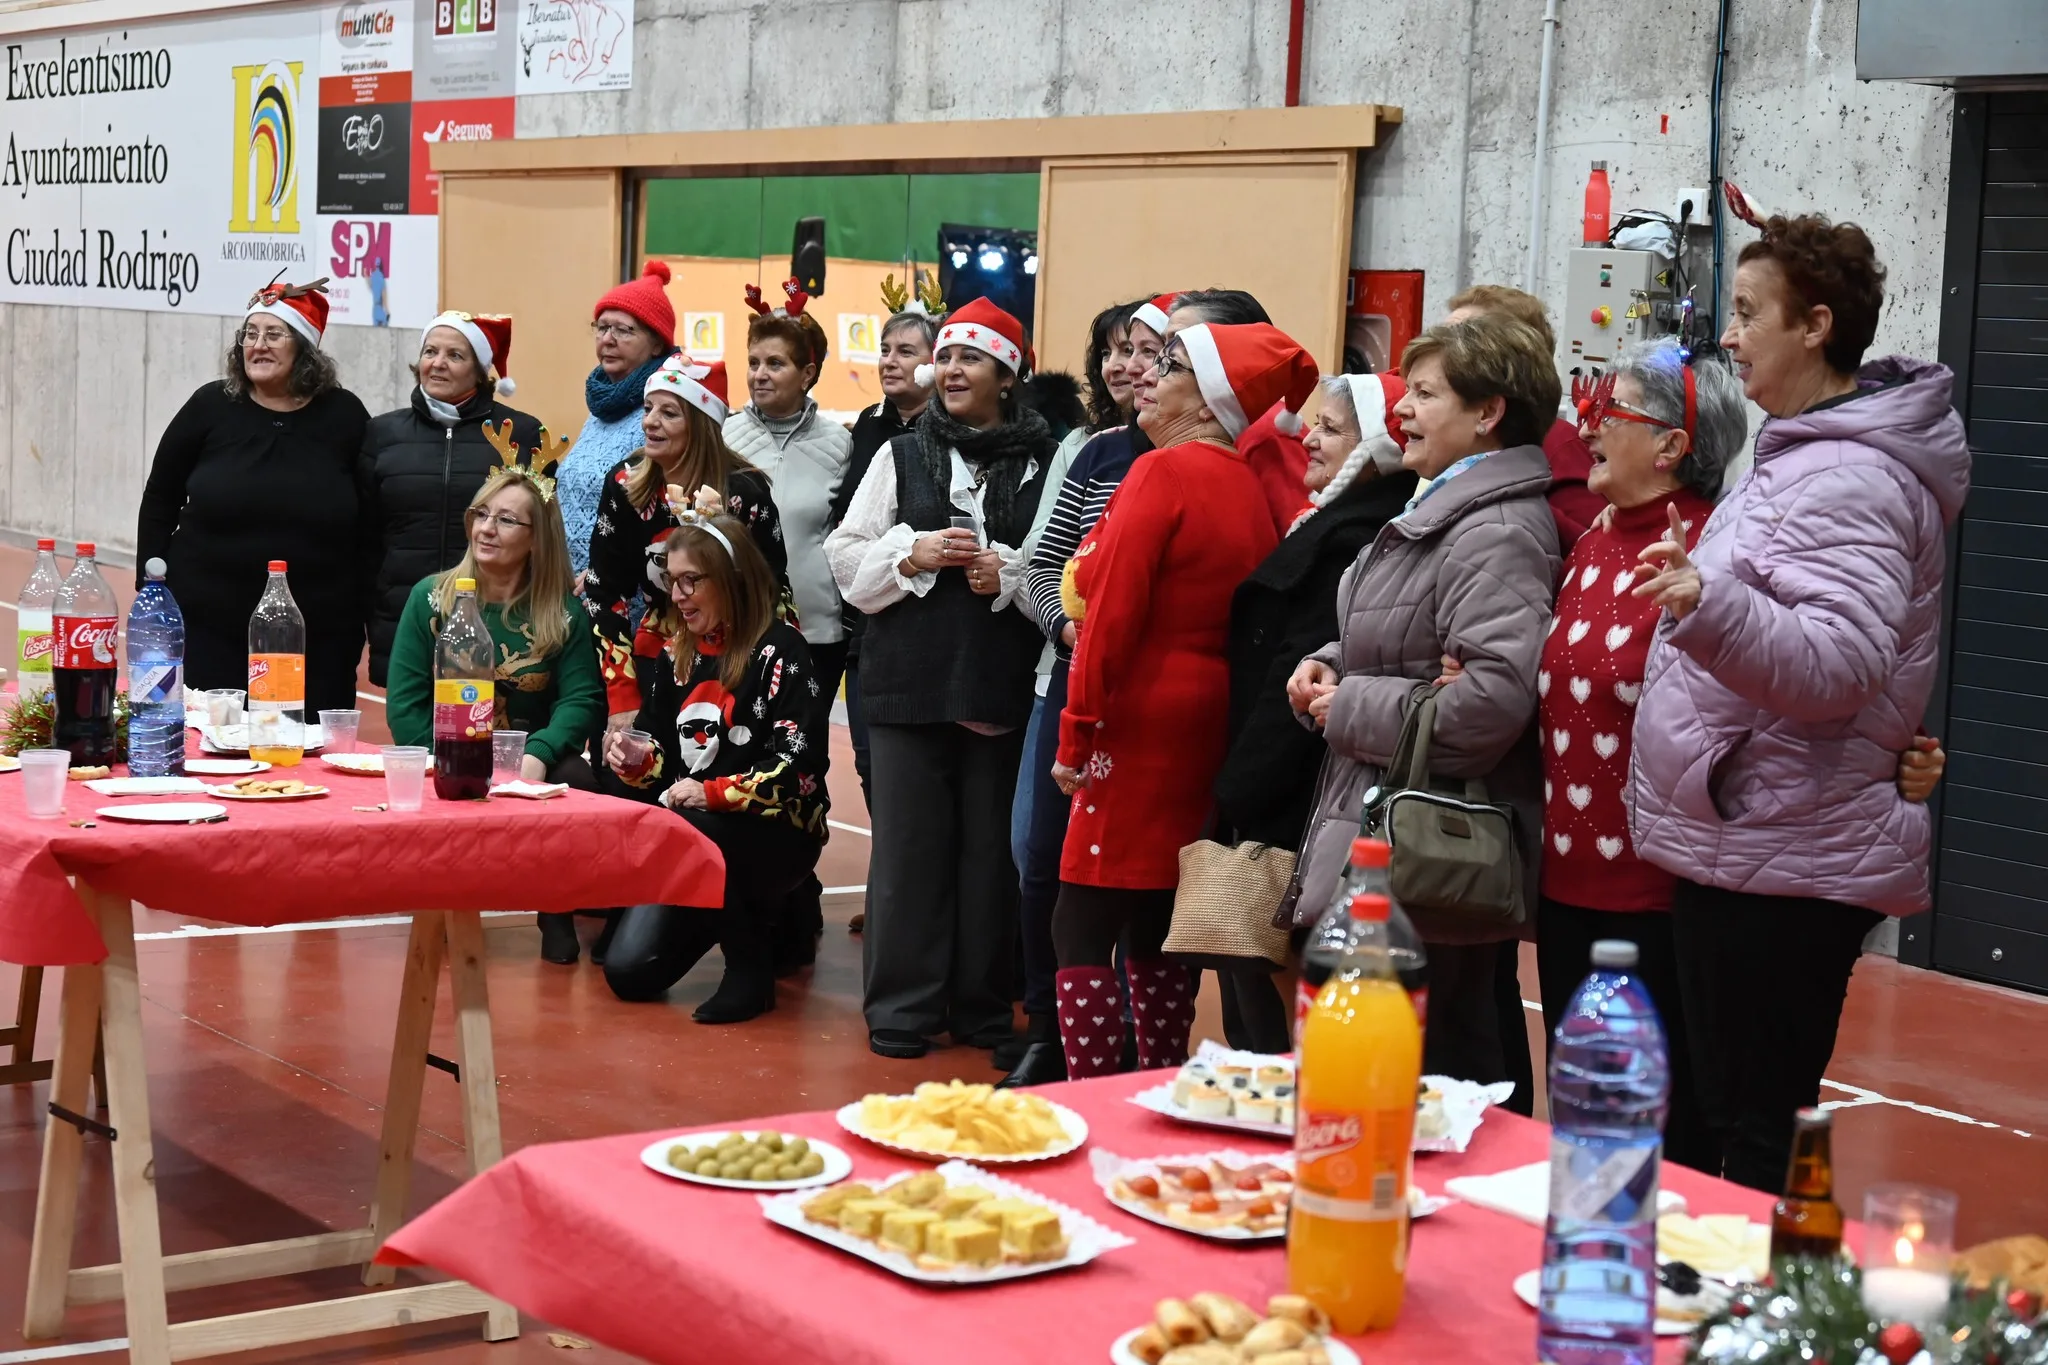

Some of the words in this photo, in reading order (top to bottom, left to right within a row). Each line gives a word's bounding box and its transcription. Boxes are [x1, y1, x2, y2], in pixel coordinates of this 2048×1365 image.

[341, 8, 394, 37] multiCía
[438, 0, 493, 28] BdB
[6, 31, 171, 101] Excelentísimo
[447, 120, 492, 142] Seguros
[2, 124, 168, 199] Ayuntamiento
[220, 238, 305, 262] ARCOMIRÓBRIGA
[7, 227, 88, 288] Ciudad
[96, 229, 199, 307] Rodrigo
